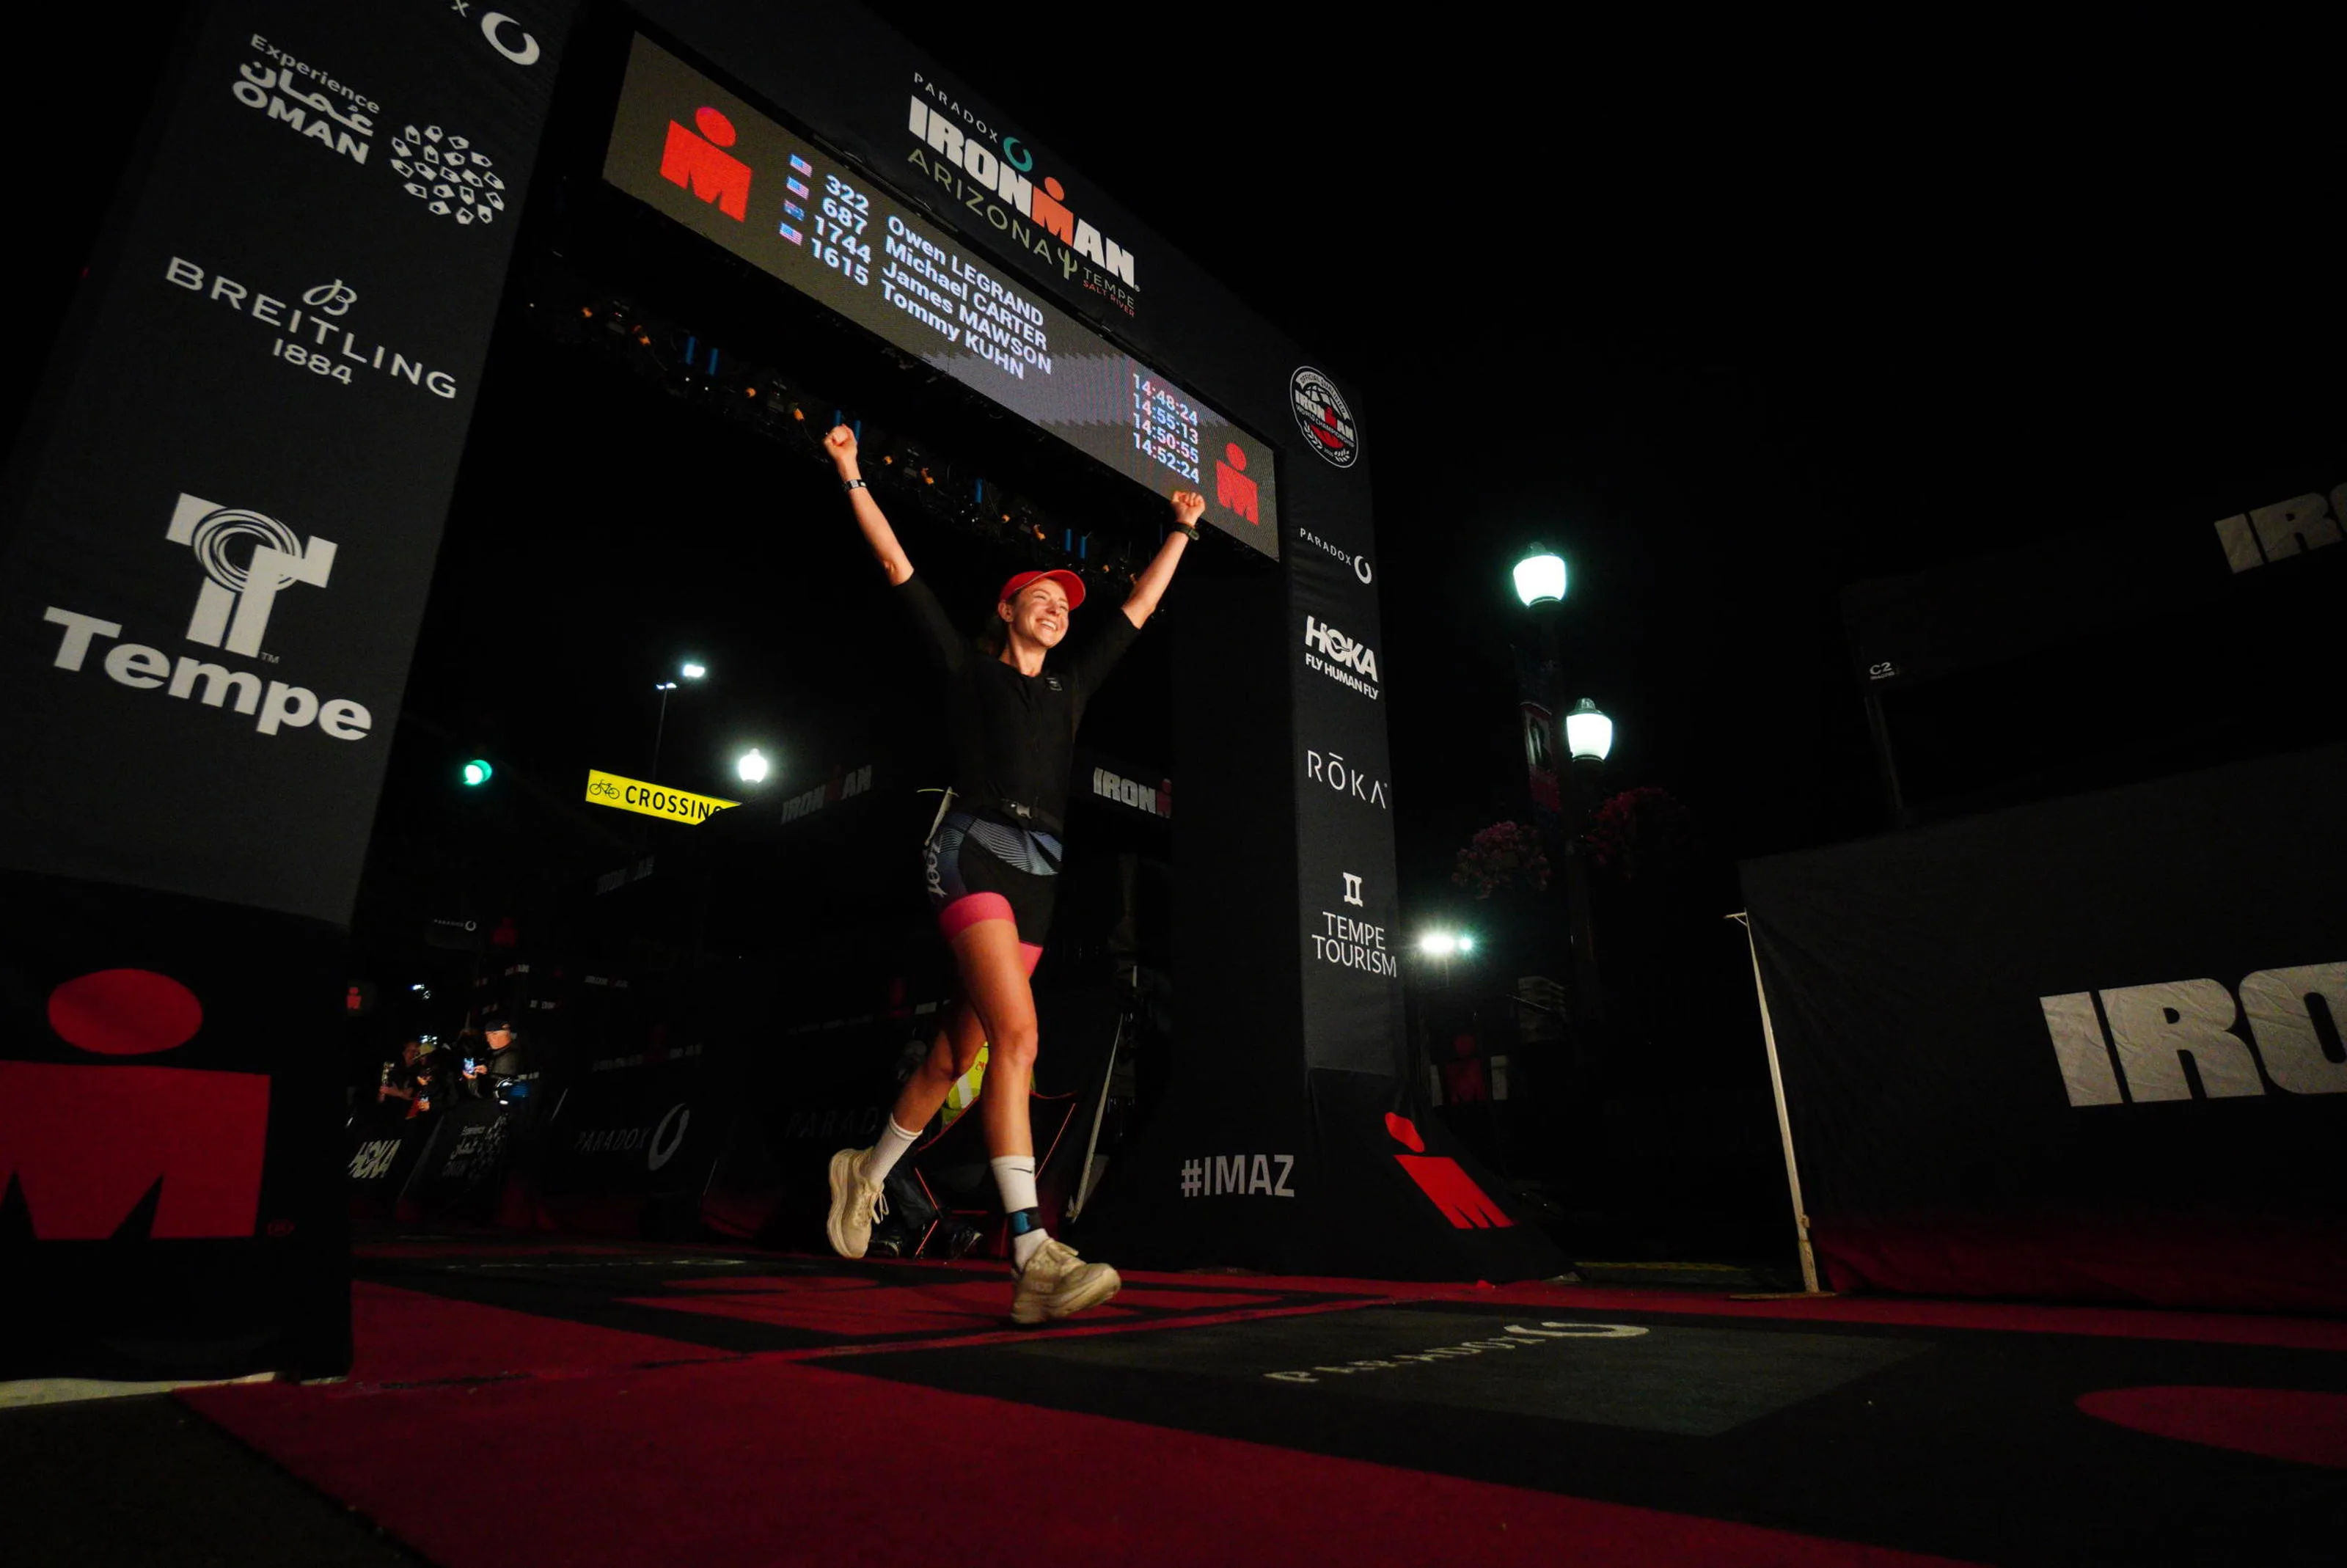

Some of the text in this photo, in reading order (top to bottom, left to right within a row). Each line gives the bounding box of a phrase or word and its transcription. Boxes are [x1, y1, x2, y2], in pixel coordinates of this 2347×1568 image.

[250, 34, 381, 114] Experience
[232, 80, 370, 165] OMAN
[914, 72, 998, 144] PARADOX
[821, 197, 868, 235] 687
[825, 174, 870, 216] 322
[907, 148, 1053, 265] ARIZONA
[908, 95, 1135, 289] IRONMAN
[810, 237, 869, 286] 1615
[814, 214, 872, 265] 1744
[885, 235, 1048, 351] Michael CARTER
[887, 216, 1044, 327] Owen LEGRAND
[1083, 267, 1135, 310] TEMPE
[882, 266, 1052, 375] James MAWSON
[1083, 280, 1135, 318] SALT RIVER
[165, 256, 458, 399] BREITLING
[880, 279, 1025, 381] Tommy KUHN
[272, 337, 353, 385] 1884
[1132, 373, 1198, 425] 14:48:24
[1132, 392, 1199, 444] 14:55:13
[1132, 412, 1199, 464] 14:50:55
[1132, 432, 1200, 484] 14:52:24
[1300, 527, 1352, 566] PARADOX
[43, 606, 373, 741] Tempe
[1305, 615, 1379, 683] HOKA
[1305, 652, 1380, 700] FLY HUMAN FLY
[1311, 934, 1397, 979] TOURISM
[1322, 910, 1386, 951] TEMPE
[2038, 960, 2347, 1108] IRO
[1180, 1153, 1295, 1198] #IMAZ
